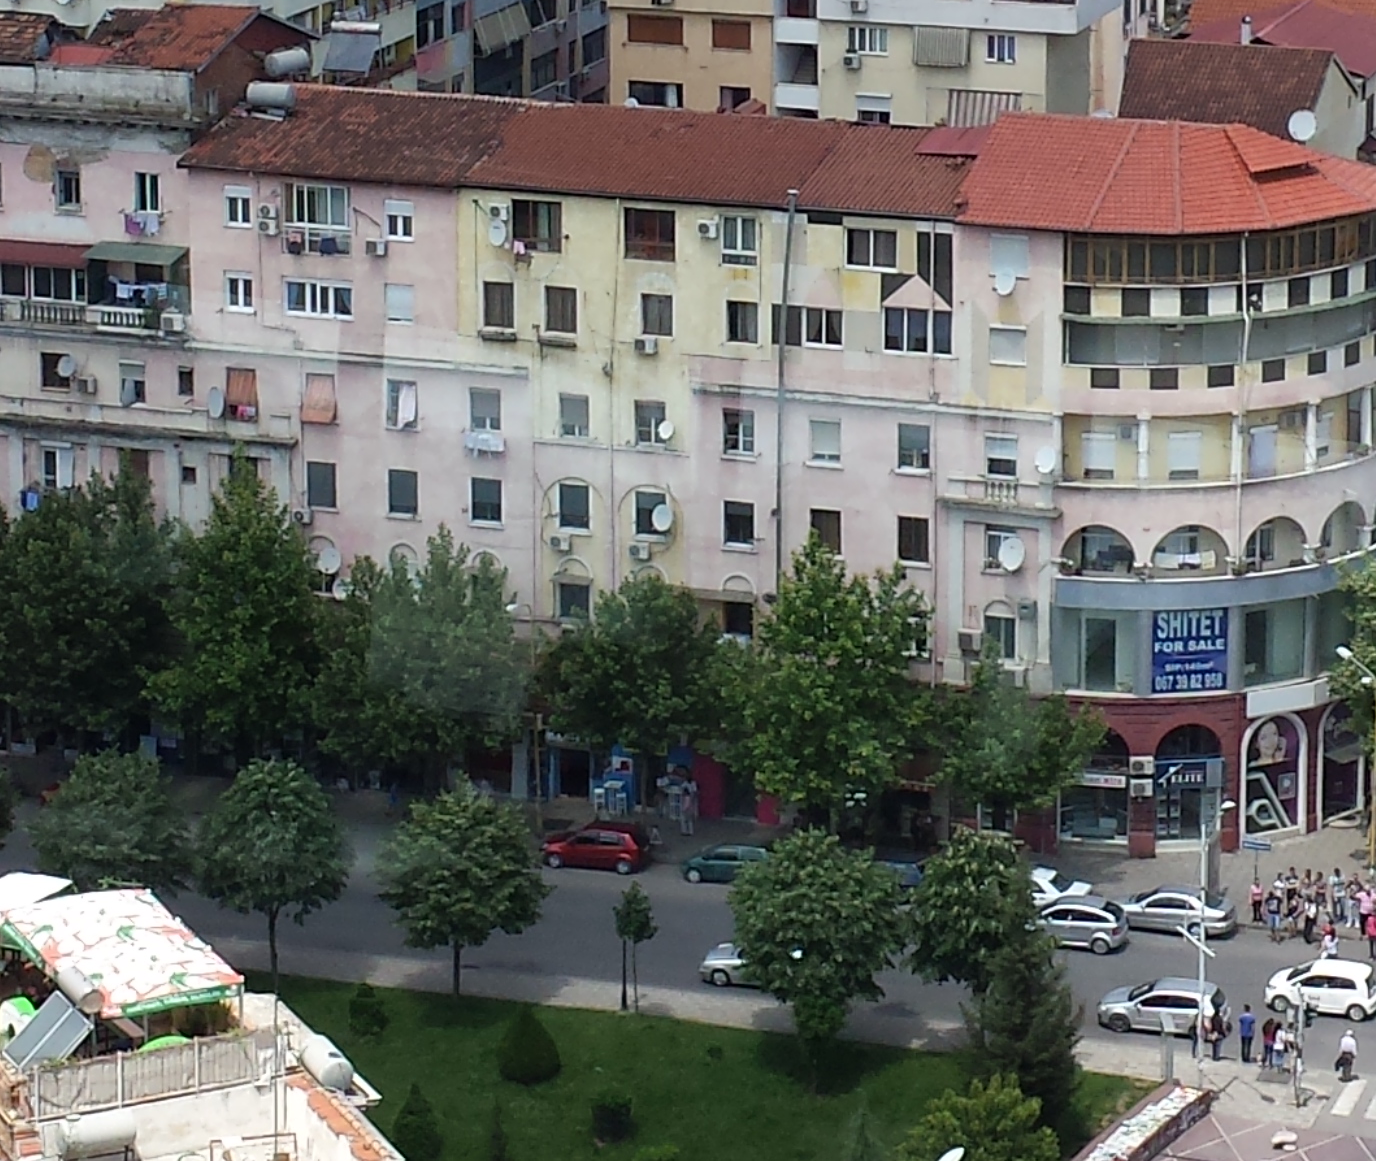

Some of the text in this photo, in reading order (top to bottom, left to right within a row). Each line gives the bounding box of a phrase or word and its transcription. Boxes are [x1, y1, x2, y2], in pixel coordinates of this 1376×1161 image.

[1156, 609, 1223, 639] SHITET
[1154, 638, 1225, 653] FOR SALE
[1171, 773, 1204, 784] ELITE
